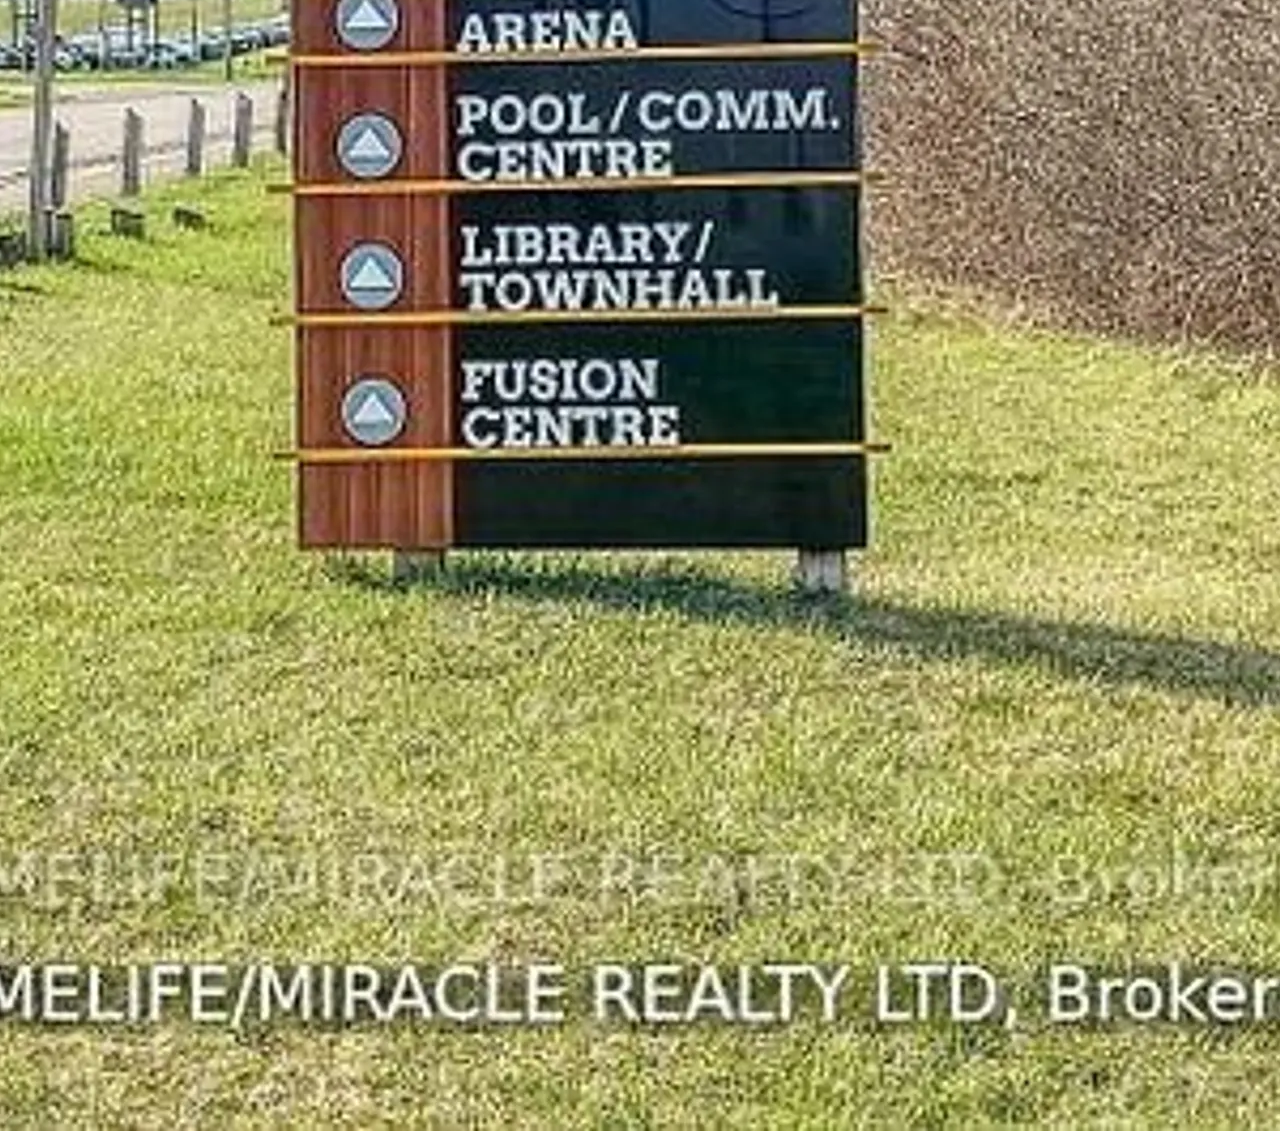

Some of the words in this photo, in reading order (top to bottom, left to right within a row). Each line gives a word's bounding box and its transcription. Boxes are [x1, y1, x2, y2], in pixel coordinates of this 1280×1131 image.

[456, 10, 638, 53] ARENA
[456, 93, 599, 136] POOL
[638, 89, 842, 132] COMM.
[456, 140, 673, 182] CENTRE
[460, 221, 715, 266] LIBRARY/
[461, 269, 780, 313] TOWNHALL
[460, 358, 660, 403] FUSION
[462, 406, 681, 449] CENTRE
